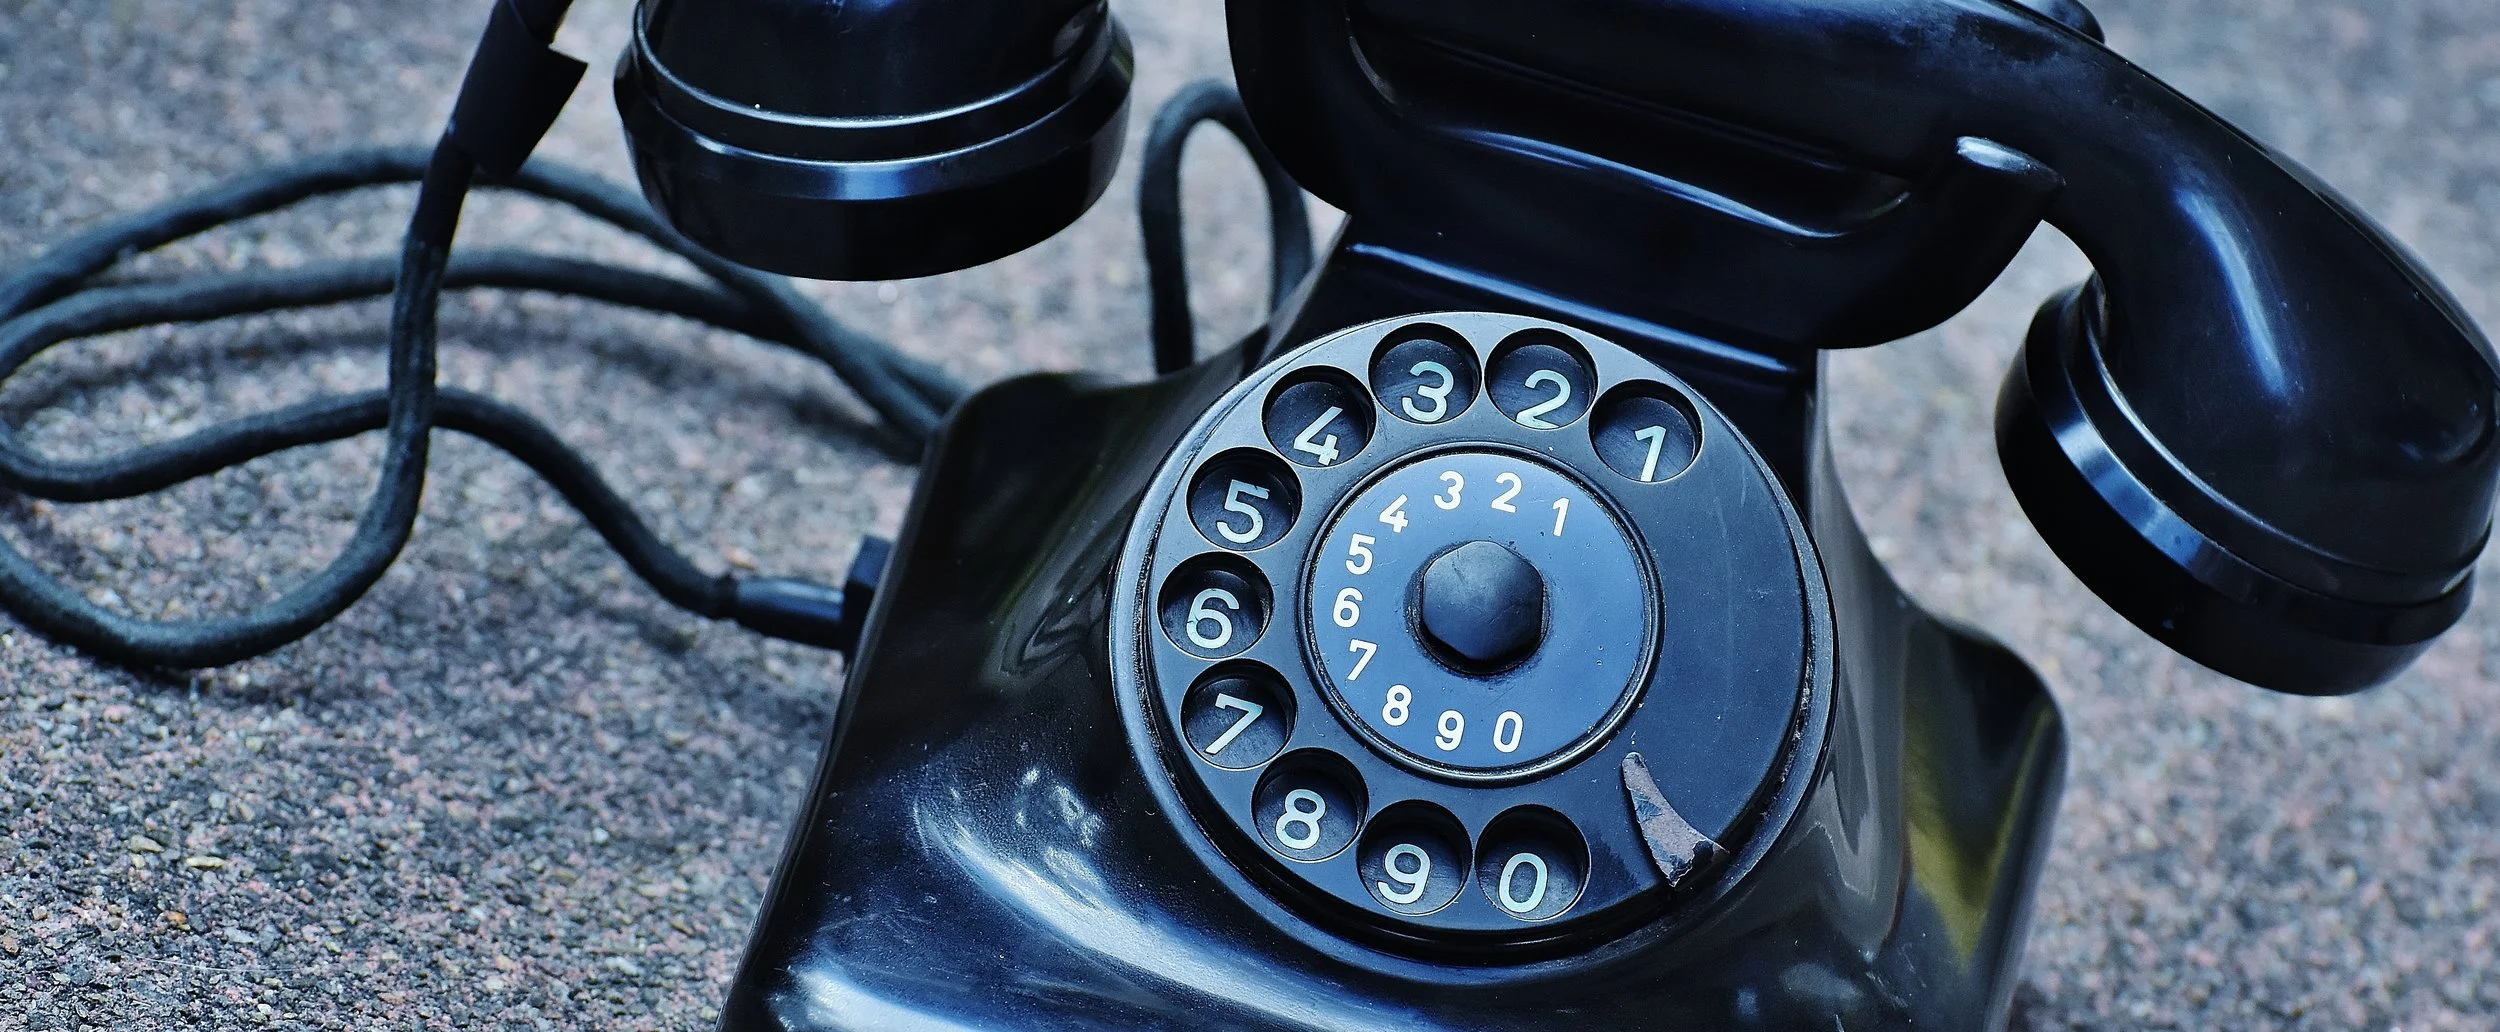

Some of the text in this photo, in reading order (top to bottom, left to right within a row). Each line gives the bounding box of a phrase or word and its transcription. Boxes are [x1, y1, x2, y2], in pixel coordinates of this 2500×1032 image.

[1402, 361, 1454, 423] 3
[1515, 370, 1571, 430] 2
[1293, 406, 1343, 466] 4
[1634, 425, 1667, 482] 1
[1216, 480, 1270, 544] 5
[1379, 495, 1409, 533] 4
[1434, 471, 1465, 510] 3
[1492, 472, 1523, 513] 2
[1552, 497, 1571, 536] 1
[1345, 534, 1376, 575] 5
[1186, 588, 1240, 649] 6
[1332, 587, 1362, 628] 6
[1345, 639, 1377, 681] 7
[1205, 693, 1264, 755] 7
[1382, 684, 1411, 727] 8
[1434, 709, 1464, 751] 9
[1493, 710, 1524, 753] 0
[1274, 788, 1326, 850] 8
[1377, 843, 1431, 904] 9
[1498, 852, 1548, 913] 0
